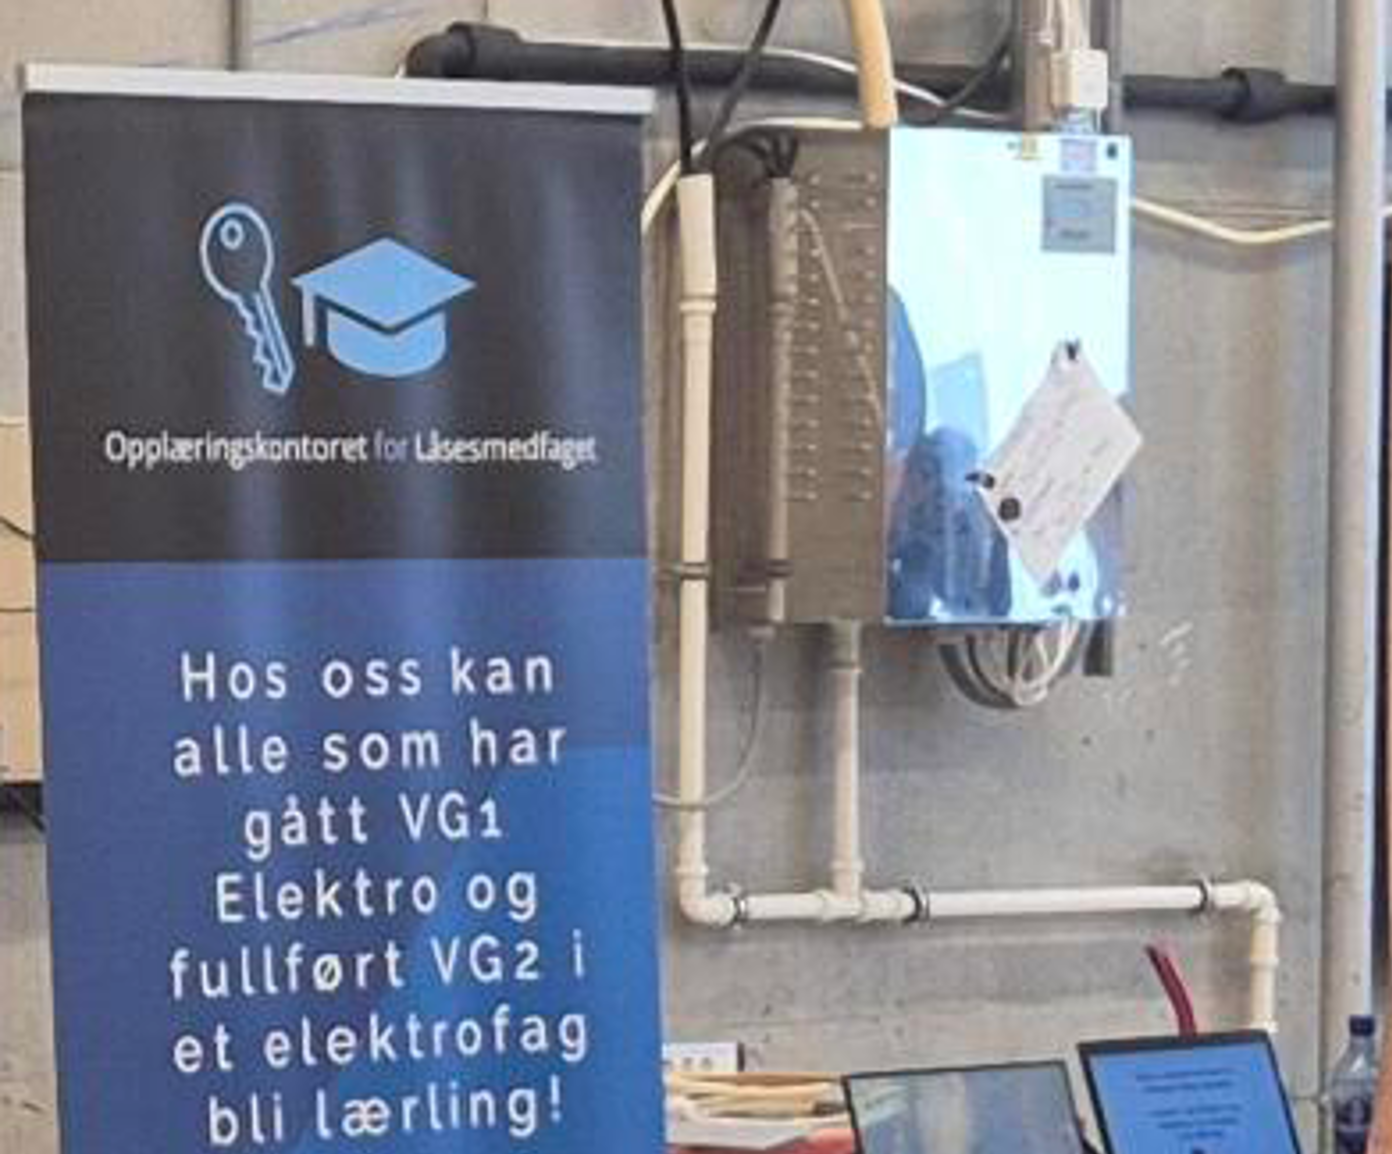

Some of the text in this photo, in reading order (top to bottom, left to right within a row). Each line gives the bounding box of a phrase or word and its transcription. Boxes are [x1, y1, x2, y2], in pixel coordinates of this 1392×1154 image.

[104, 429, 598, 471] Opplæringskontoret for Låsesmedfaget
[181, 646, 553, 701] Hos oss kan
[174, 718, 566, 777] alle som har
[244, 790, 502, 862] gått VG1
[216, 868, 537, 923] Elektro og
[170, 929, 584, 999] fullført VG2 i
[173, 1003, 587, 1074] et elektrofag
[209, 1075, 560, 1146] bli lærling!
